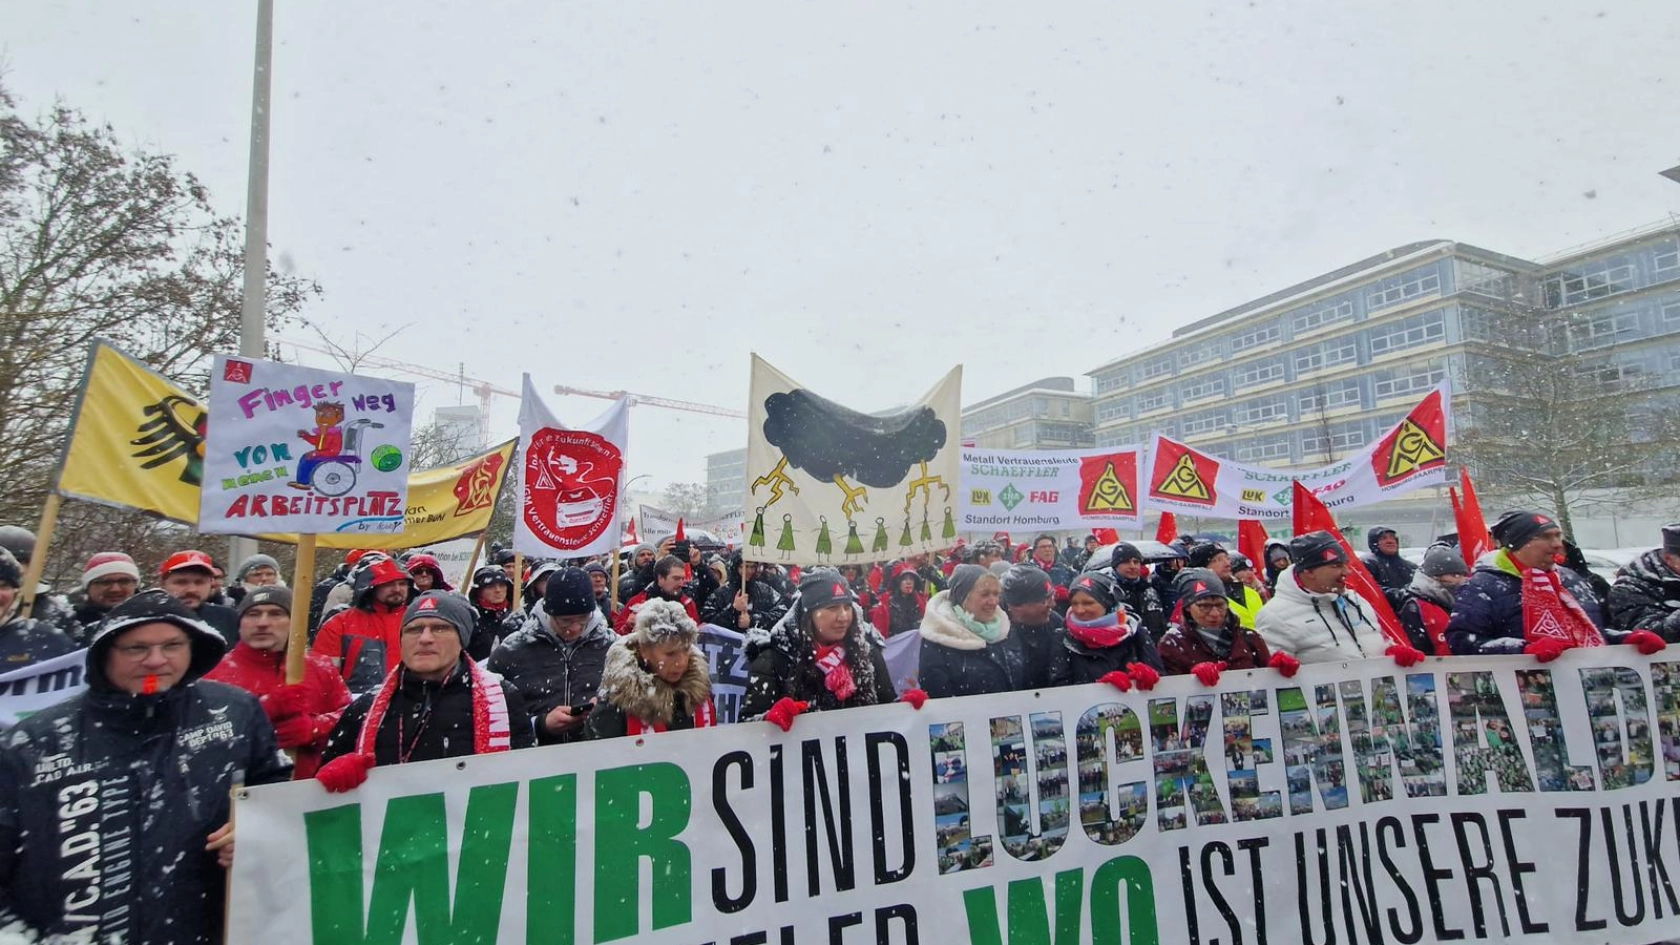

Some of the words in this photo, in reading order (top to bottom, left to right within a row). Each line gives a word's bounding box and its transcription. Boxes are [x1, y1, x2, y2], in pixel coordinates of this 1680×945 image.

[238, 380, 343, 419] Finger
[233, 442, 294, 469] von
[963, 453, 994, 464] Metall
[997, 455, 1079, 466] Vertrauensleute
[970, 464, 1060, 477] SCHAEFFLER
[1091, 466, 1130, 507] IGM
[1163, 456, 1205, 496] IGM
[1030, 491, 1060, 503] FAG
[1238, 505, 1290, 518] Standort
[1323, 495, 1355, 509] burg
[965, 514, 1010, 524] Standort
[1013, 515, 1060, 525] Homburg
[101, 775, 130, 823] TYPE
[304, 760, 693, 945] WIR
[711, 731, 915, 914] SIND
[103, 825, 132, 899] ENGINE
[1178, 837, 1269, 945] IST
[1295, 807, 1549, 945] UNSERE
